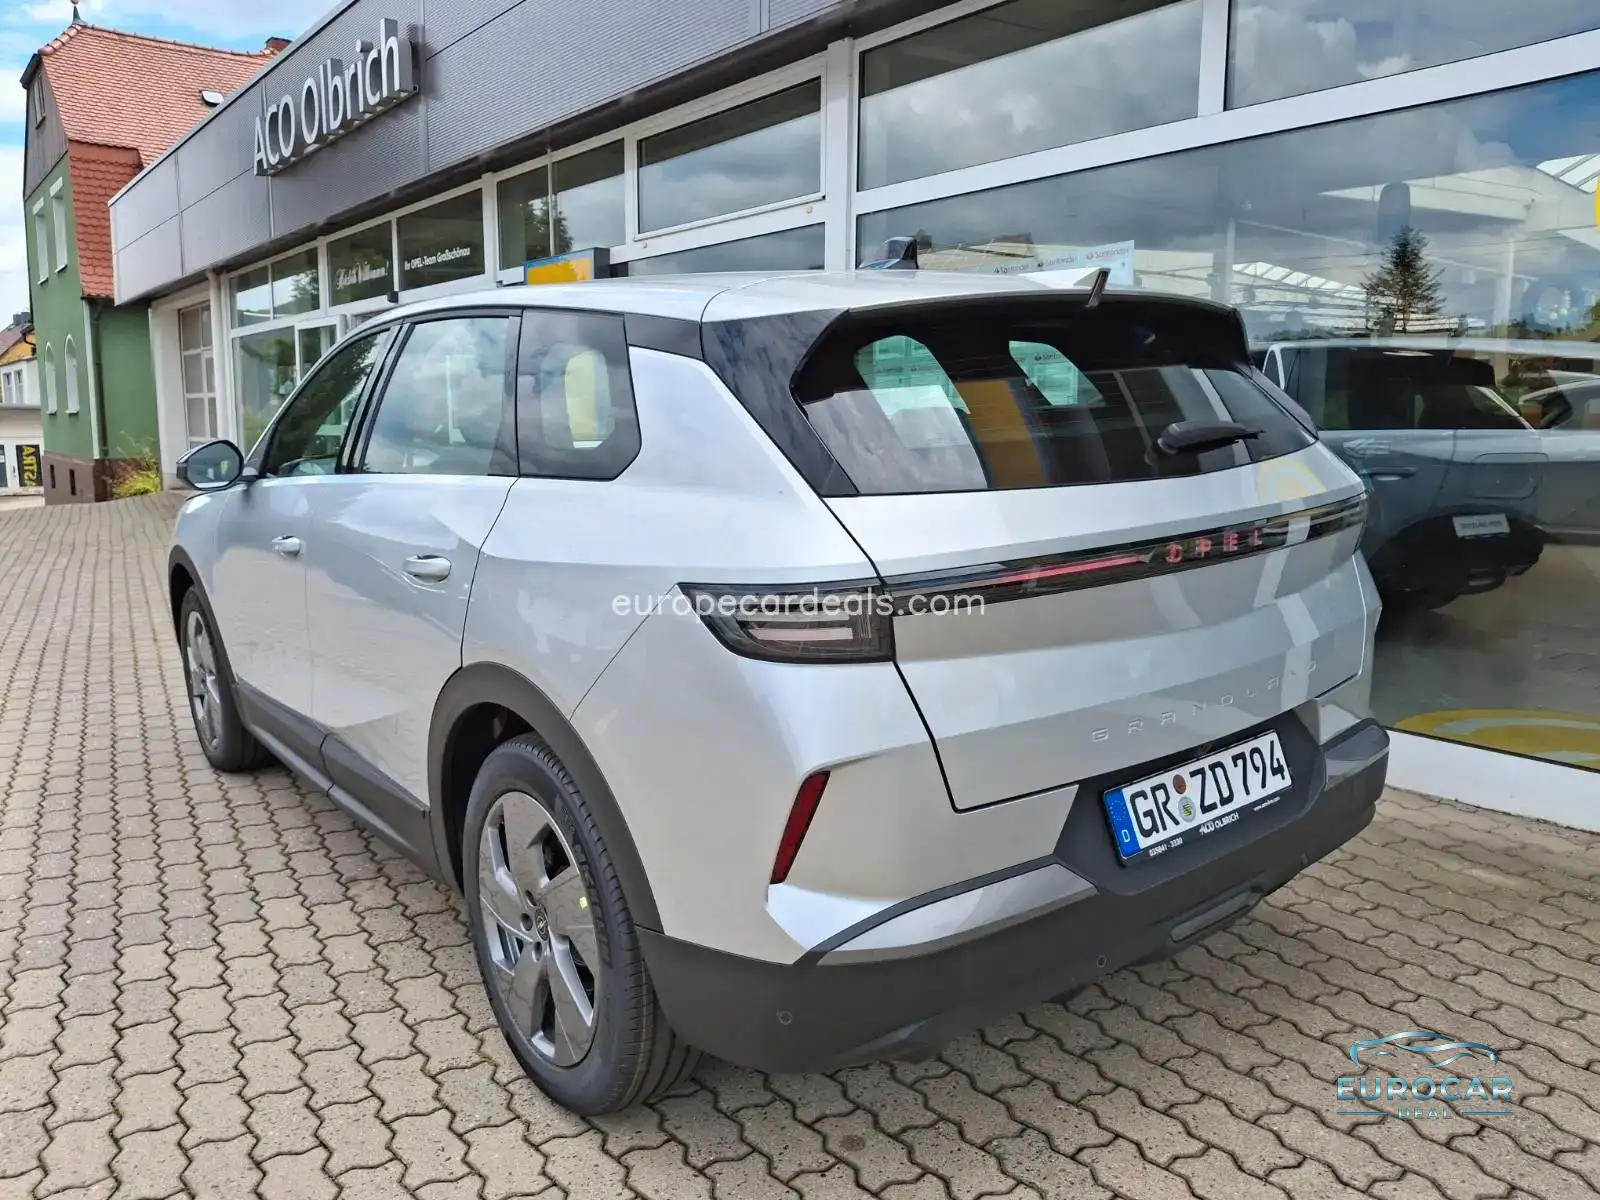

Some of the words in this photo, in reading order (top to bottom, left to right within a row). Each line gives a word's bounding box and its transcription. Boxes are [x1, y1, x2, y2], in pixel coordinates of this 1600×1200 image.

[254, 94, 296, 176] ACO
[301, 18, 402, 144] Olbrich
[1165, 527, 1263, 564] OPEL
[1129, 782, 1180, 838] GR
[1189, 761, 1235, 814] ZD
[1232, 740, 1286, 796] 794
[1121, 829, 1131, 843] D
